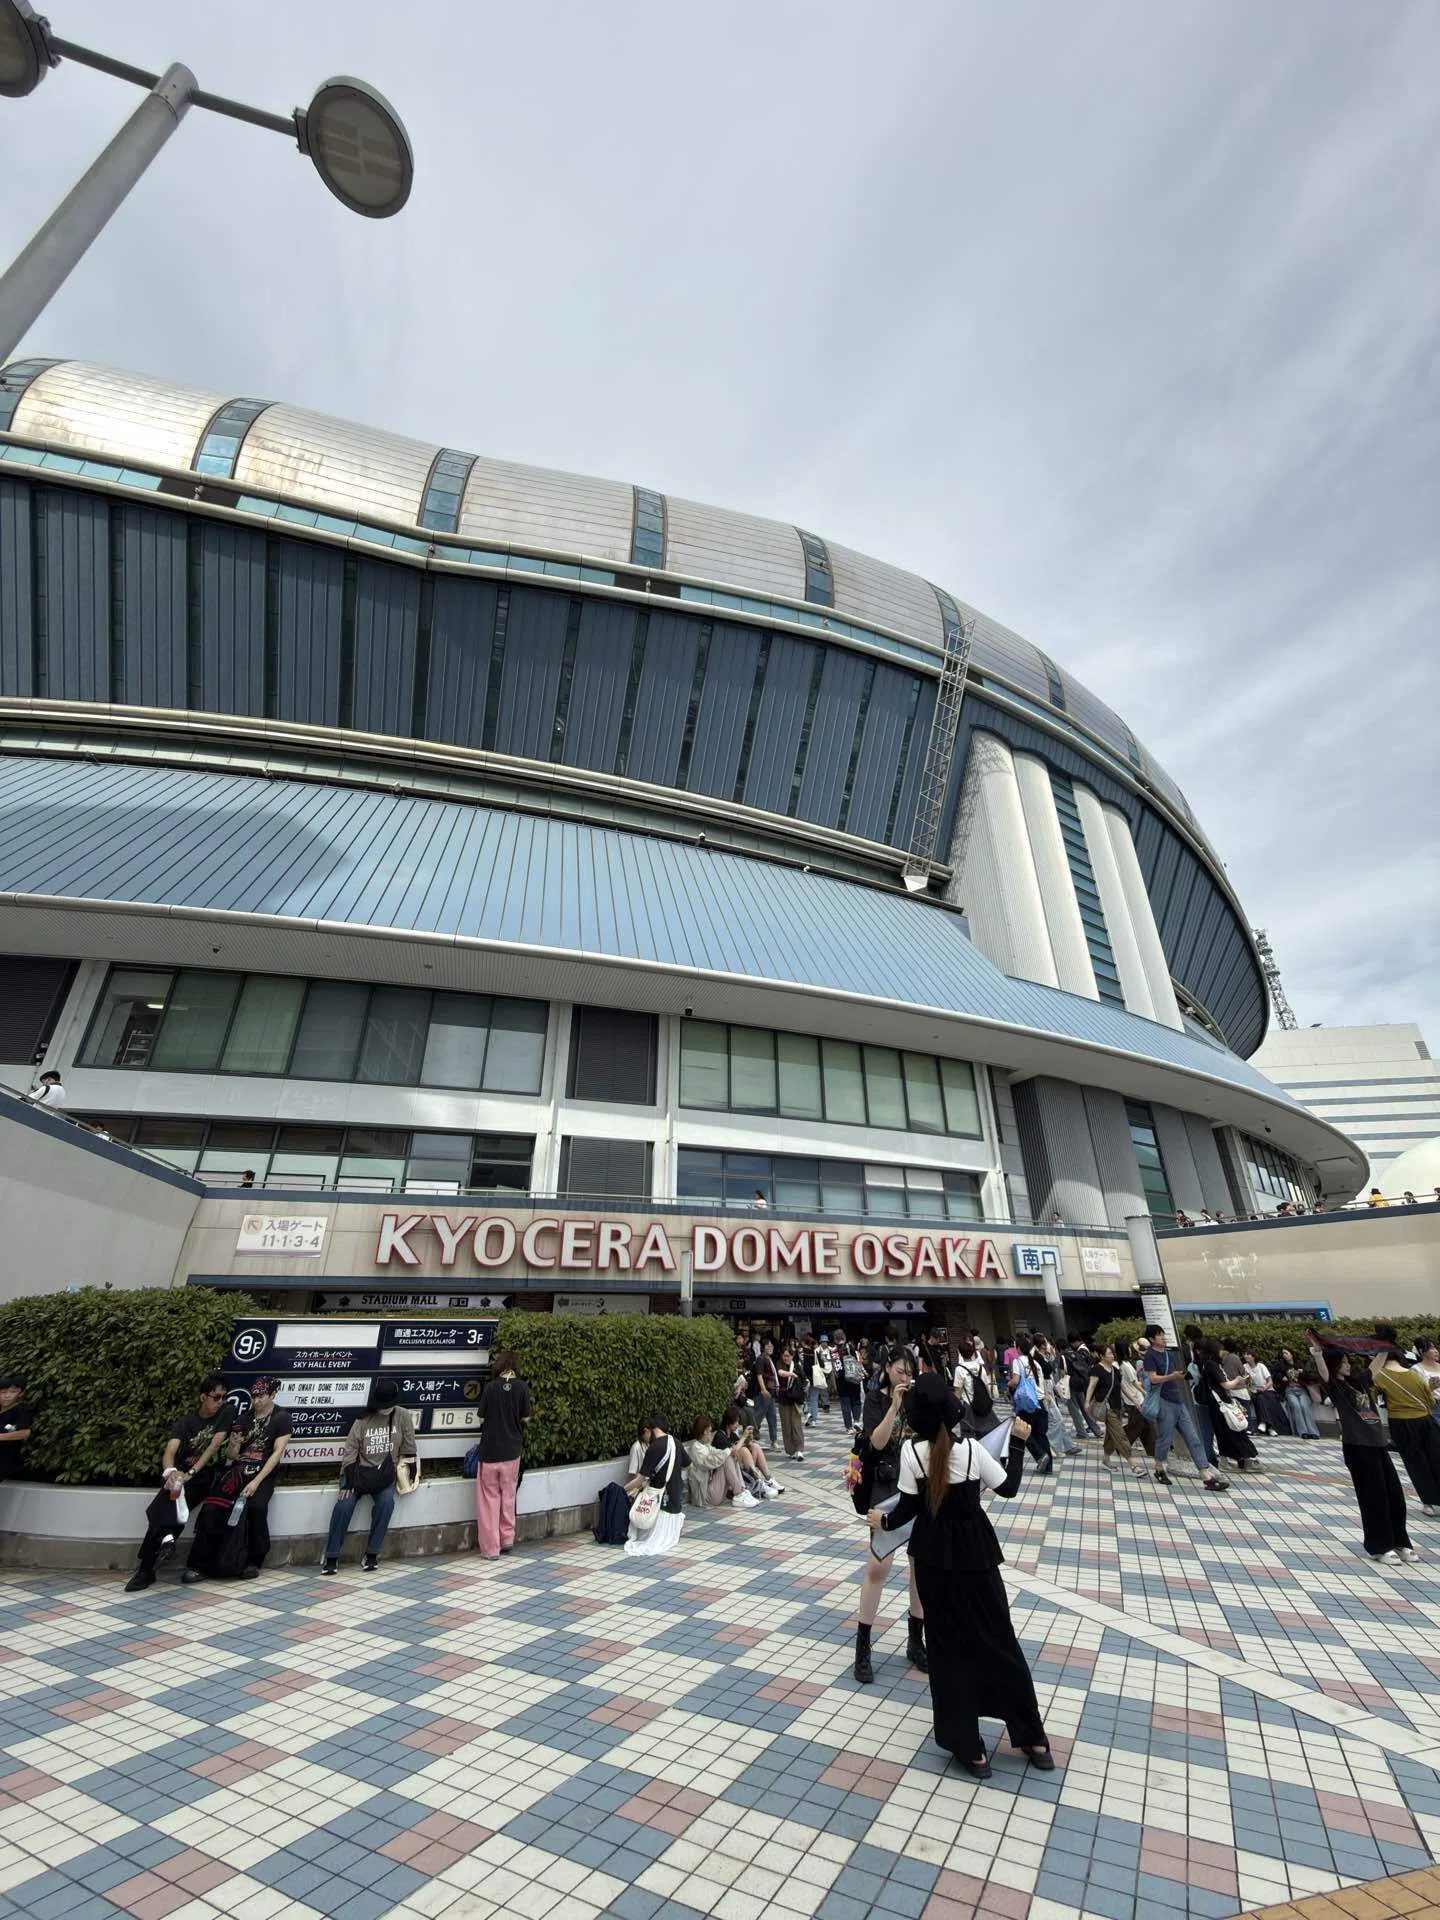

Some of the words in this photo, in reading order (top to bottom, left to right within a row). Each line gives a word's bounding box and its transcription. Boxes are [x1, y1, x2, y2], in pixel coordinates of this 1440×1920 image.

[265, 1220, 323, 1232] 入場ゲート
[375, 1213, 677, 1271] KYOCERA
[692, 1225, 841, 1275] DOME
[852, 1233, 1008, 1280] OSAKA
[361, 1295, 408, 1305] STADIUM
[410, 1295, 439, 1305] MALL
[788, 1299, 821, 1309] STADIUM
[823, 1299, 842, 1309] MALL
[467, 1329, 485, 1344] 3F
[238, 1335, 262, 1355] 9F
[293, 1361, 306, 1369] SKY
[288, 1383, 296, 1392] NO
[298, 1383, 315, 1392] OWARI
[318, 1383, 331, 1392] DOME
[335, 1383, 349, 1391] TOUR
[351, 1383, 365, 1391] 2026
[419, 1393, 441, 1401] GATE
[314, 1425, 340, 1434] EVENT
[284, 1448, 334, 1459] KYOCERA
